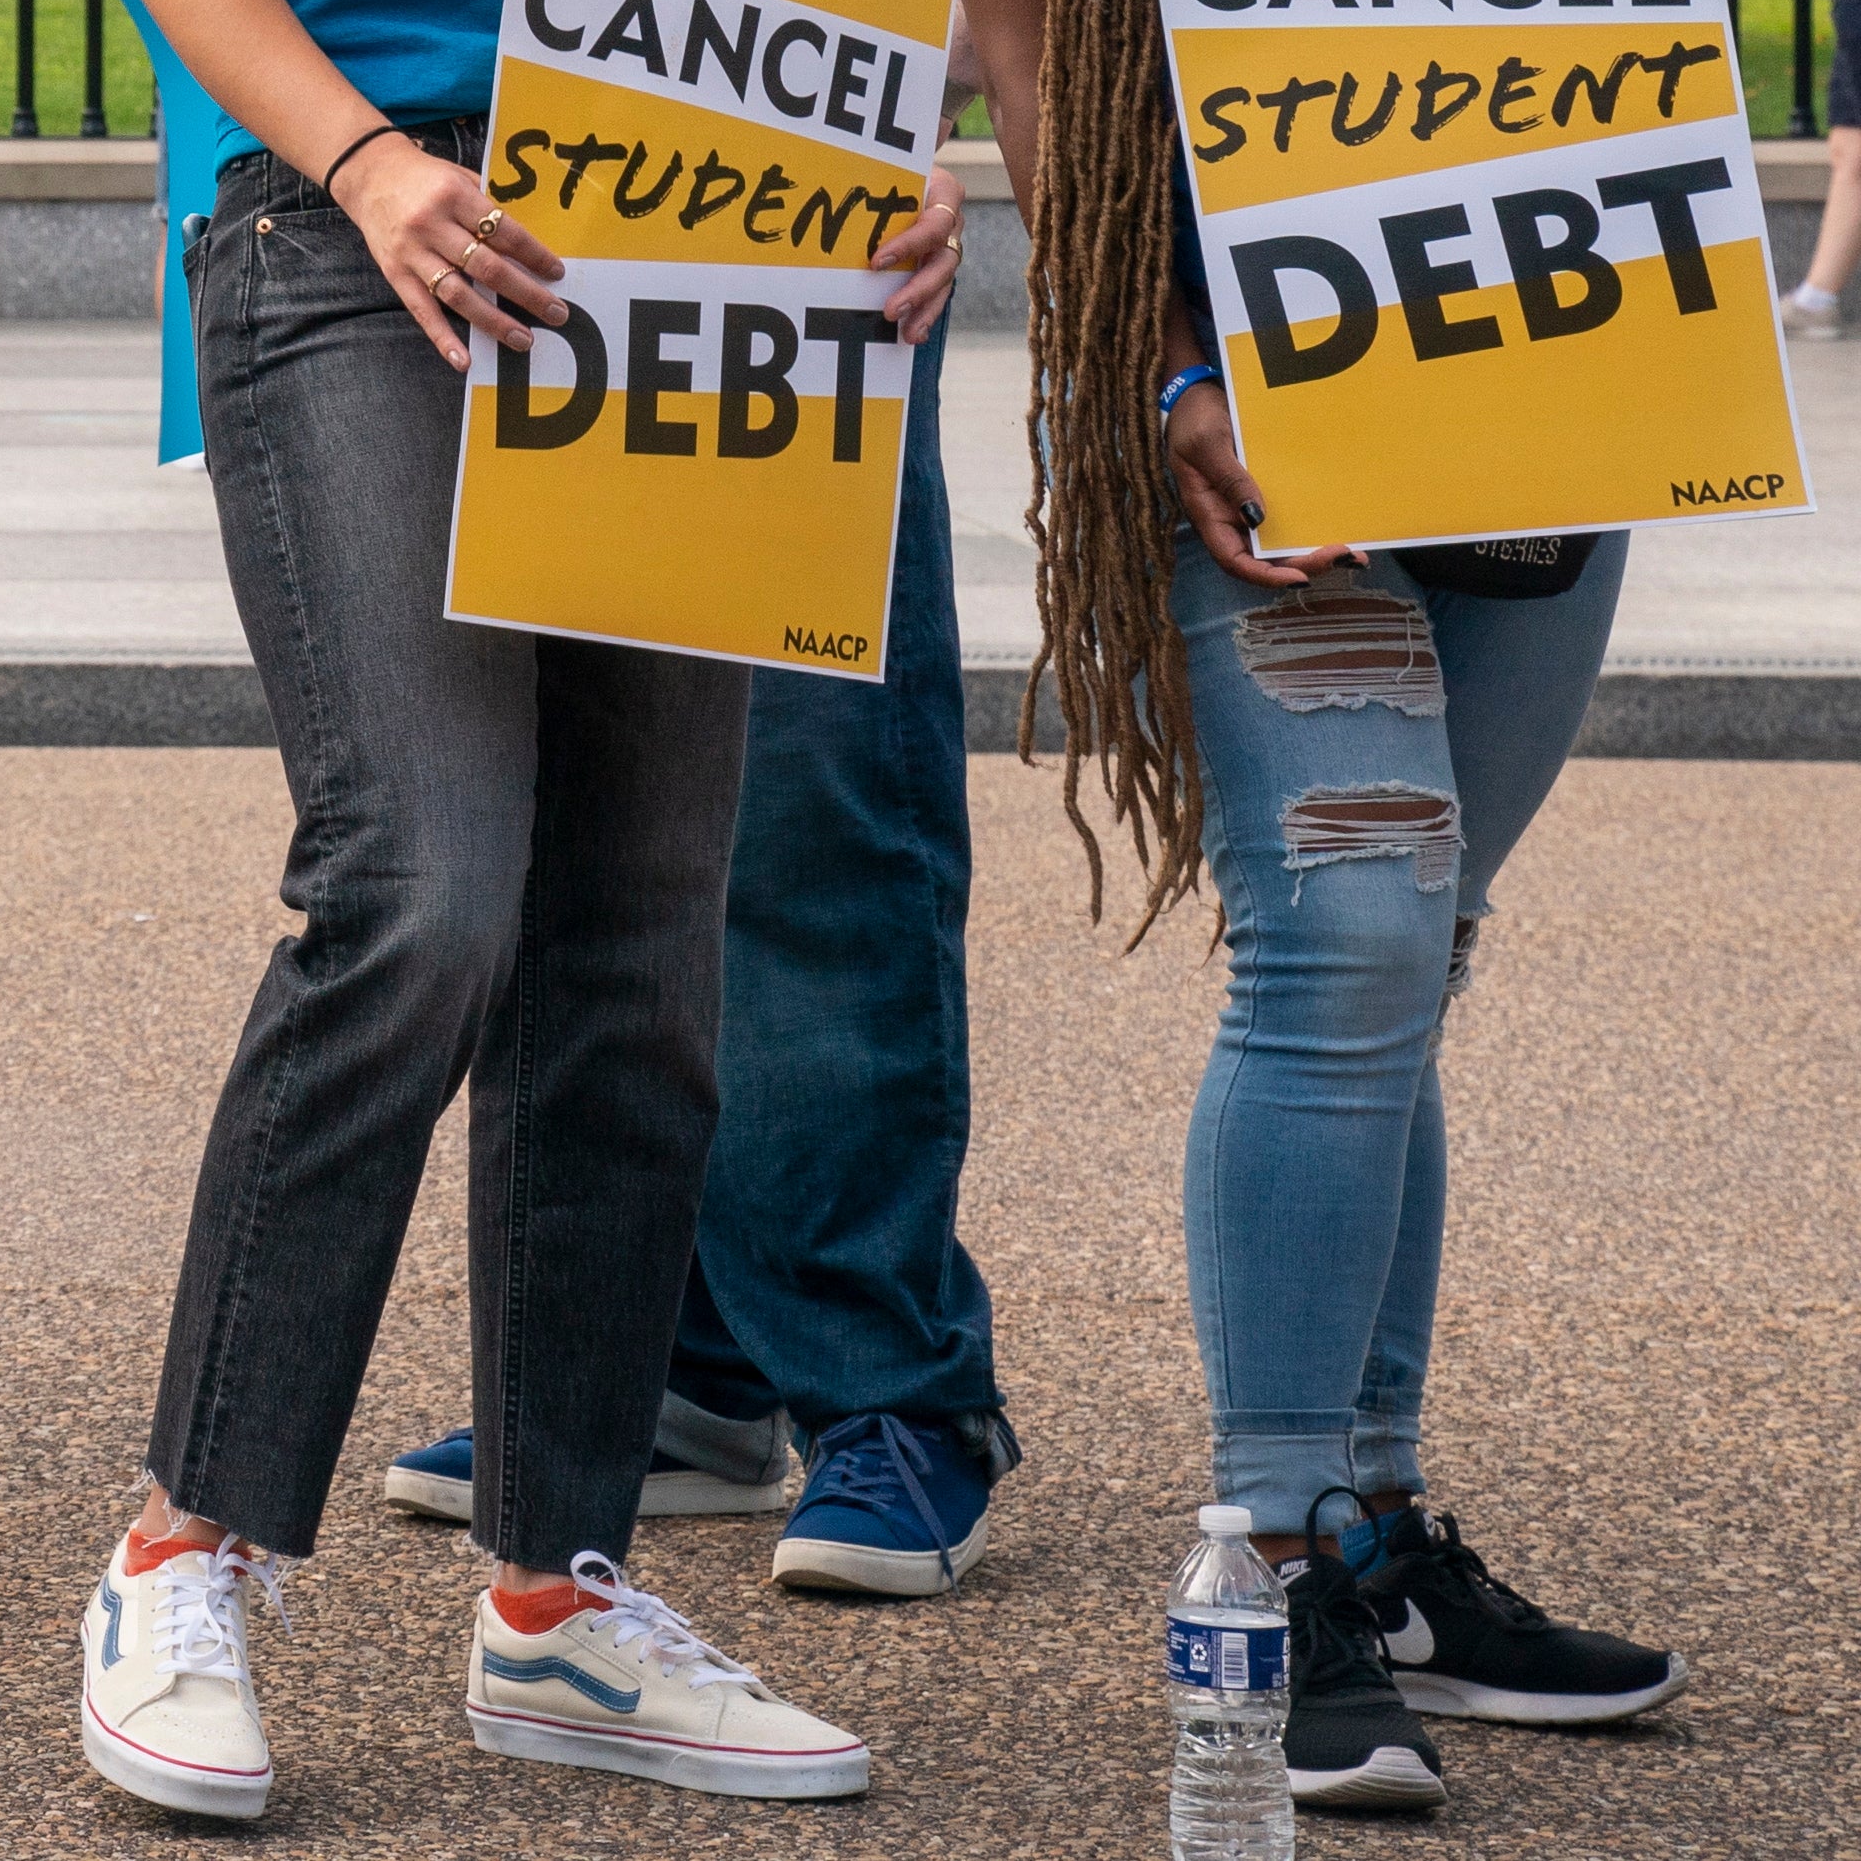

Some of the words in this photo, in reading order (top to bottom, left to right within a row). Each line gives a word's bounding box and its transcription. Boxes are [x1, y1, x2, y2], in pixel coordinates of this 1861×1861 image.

[1193, 41, 1721, 164] STUDENT
[489, 128, 919, 260] STUDENT
[1229, 156, 1732, 390] DEBT
[495, 289, 898, 464] DEBT
[1670, 474, 1785, 507] NAACP
[783, 625, 868, 662] NAACP
[1280, 1559, 1309, 1576] NIKE
